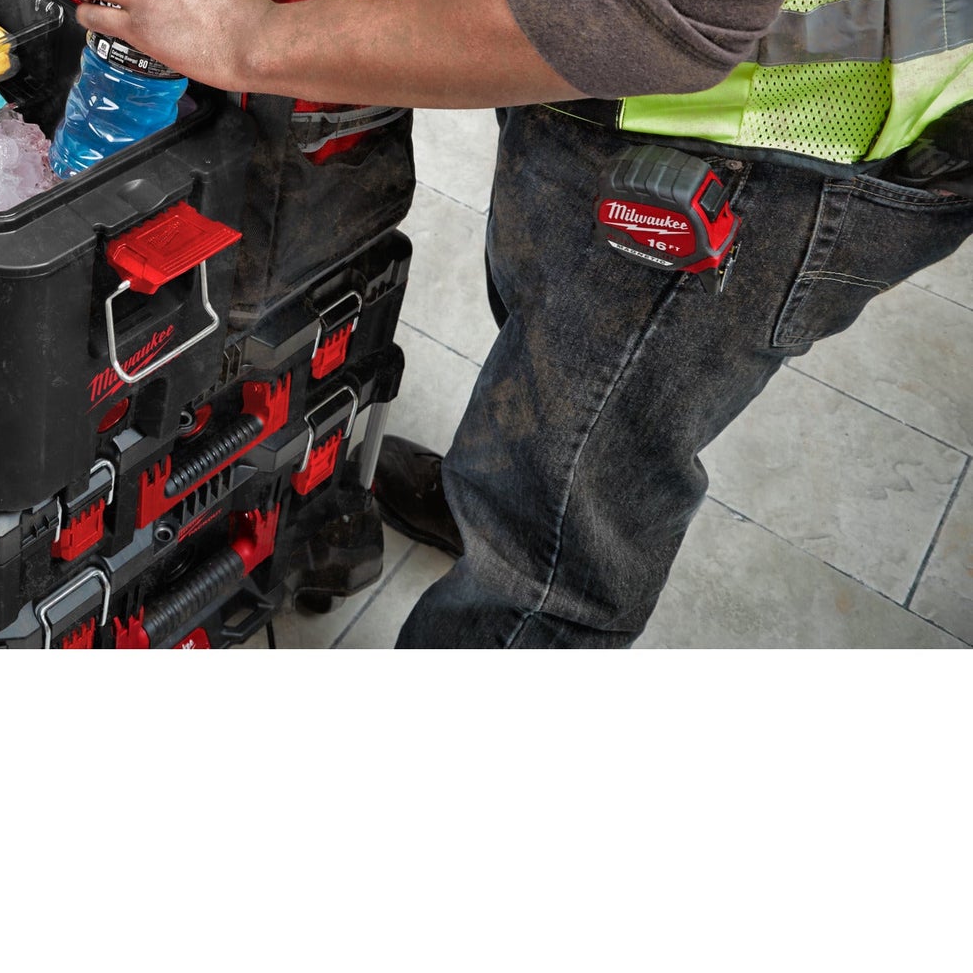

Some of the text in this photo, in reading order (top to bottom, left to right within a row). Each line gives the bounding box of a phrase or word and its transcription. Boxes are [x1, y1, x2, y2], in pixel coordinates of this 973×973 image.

[138, 59, 149, 69] 80
[605, 201, 689, 230] Milwaukee
[647, 238, 680, 252] 16 FT
